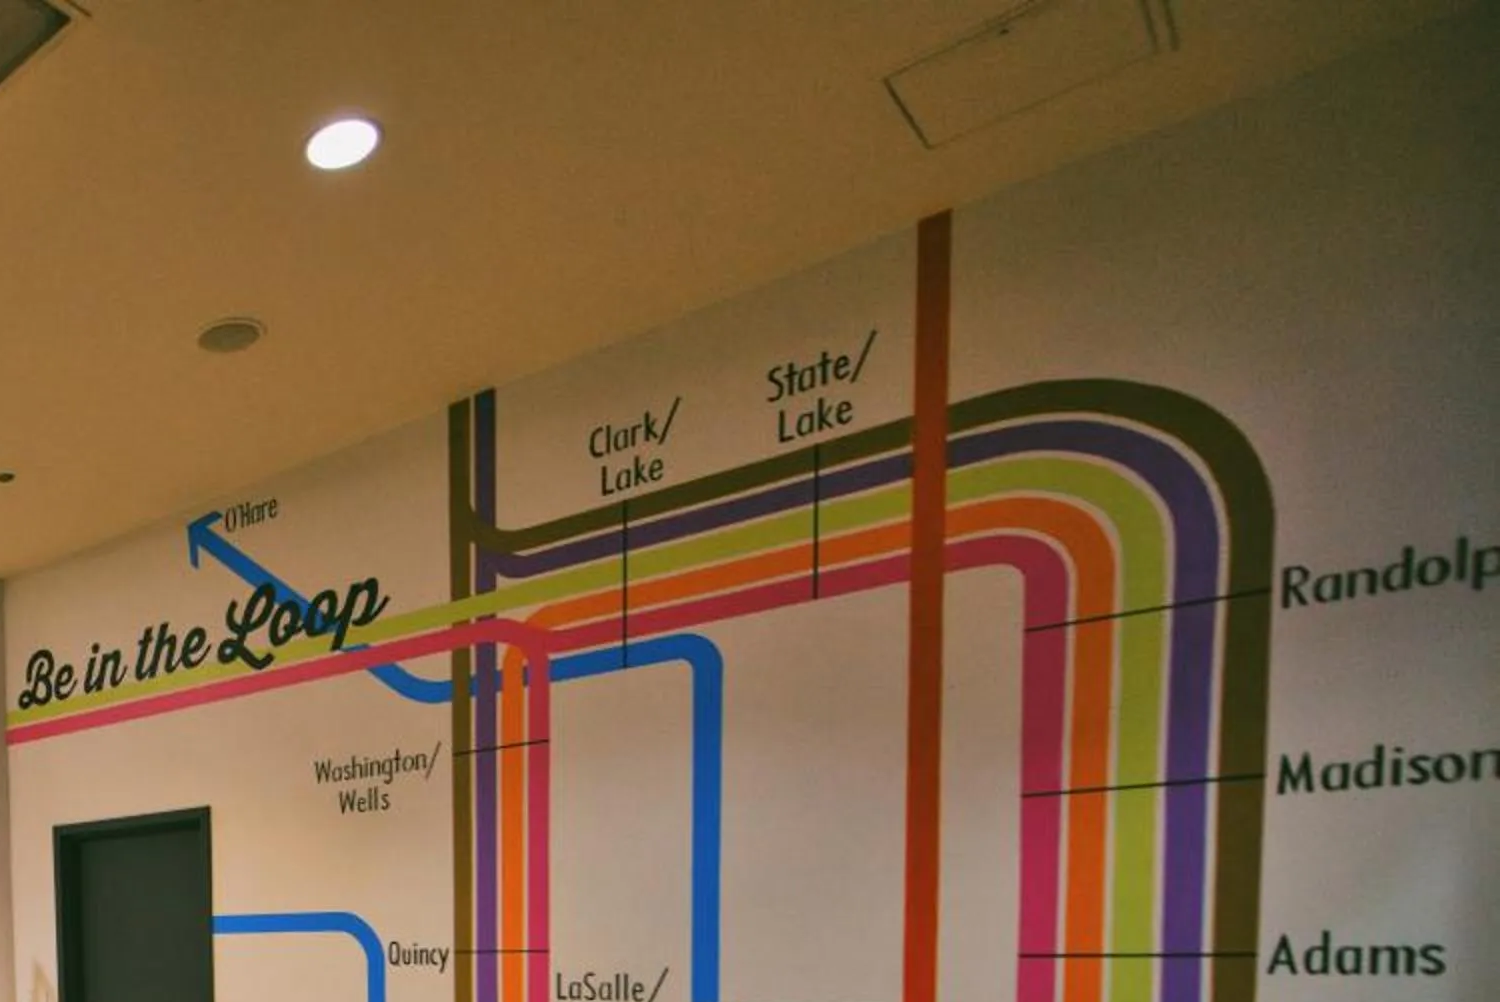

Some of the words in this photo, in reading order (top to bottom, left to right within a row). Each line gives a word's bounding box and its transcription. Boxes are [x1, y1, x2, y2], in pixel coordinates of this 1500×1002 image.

[766, 329, 878, 402] State/
[589, 396, 682, 457] Clark/
[778, 398, 854, 442] Lake
[601, 456, 665, 496] Lake
[224, 498, 278, 532] O'Hare
[19, 649, 77, 709] Be
[83, 643, 127, 693] in
[135, 622, 211, 680] the
[217, 577, 391, 670] Loop
[314, 741, 442, 785] Washington/
[338, 787, 390, 815] Wells
[387, 940, 450, 974] Quincy
[1266, 929, 1448, 976] Adams
